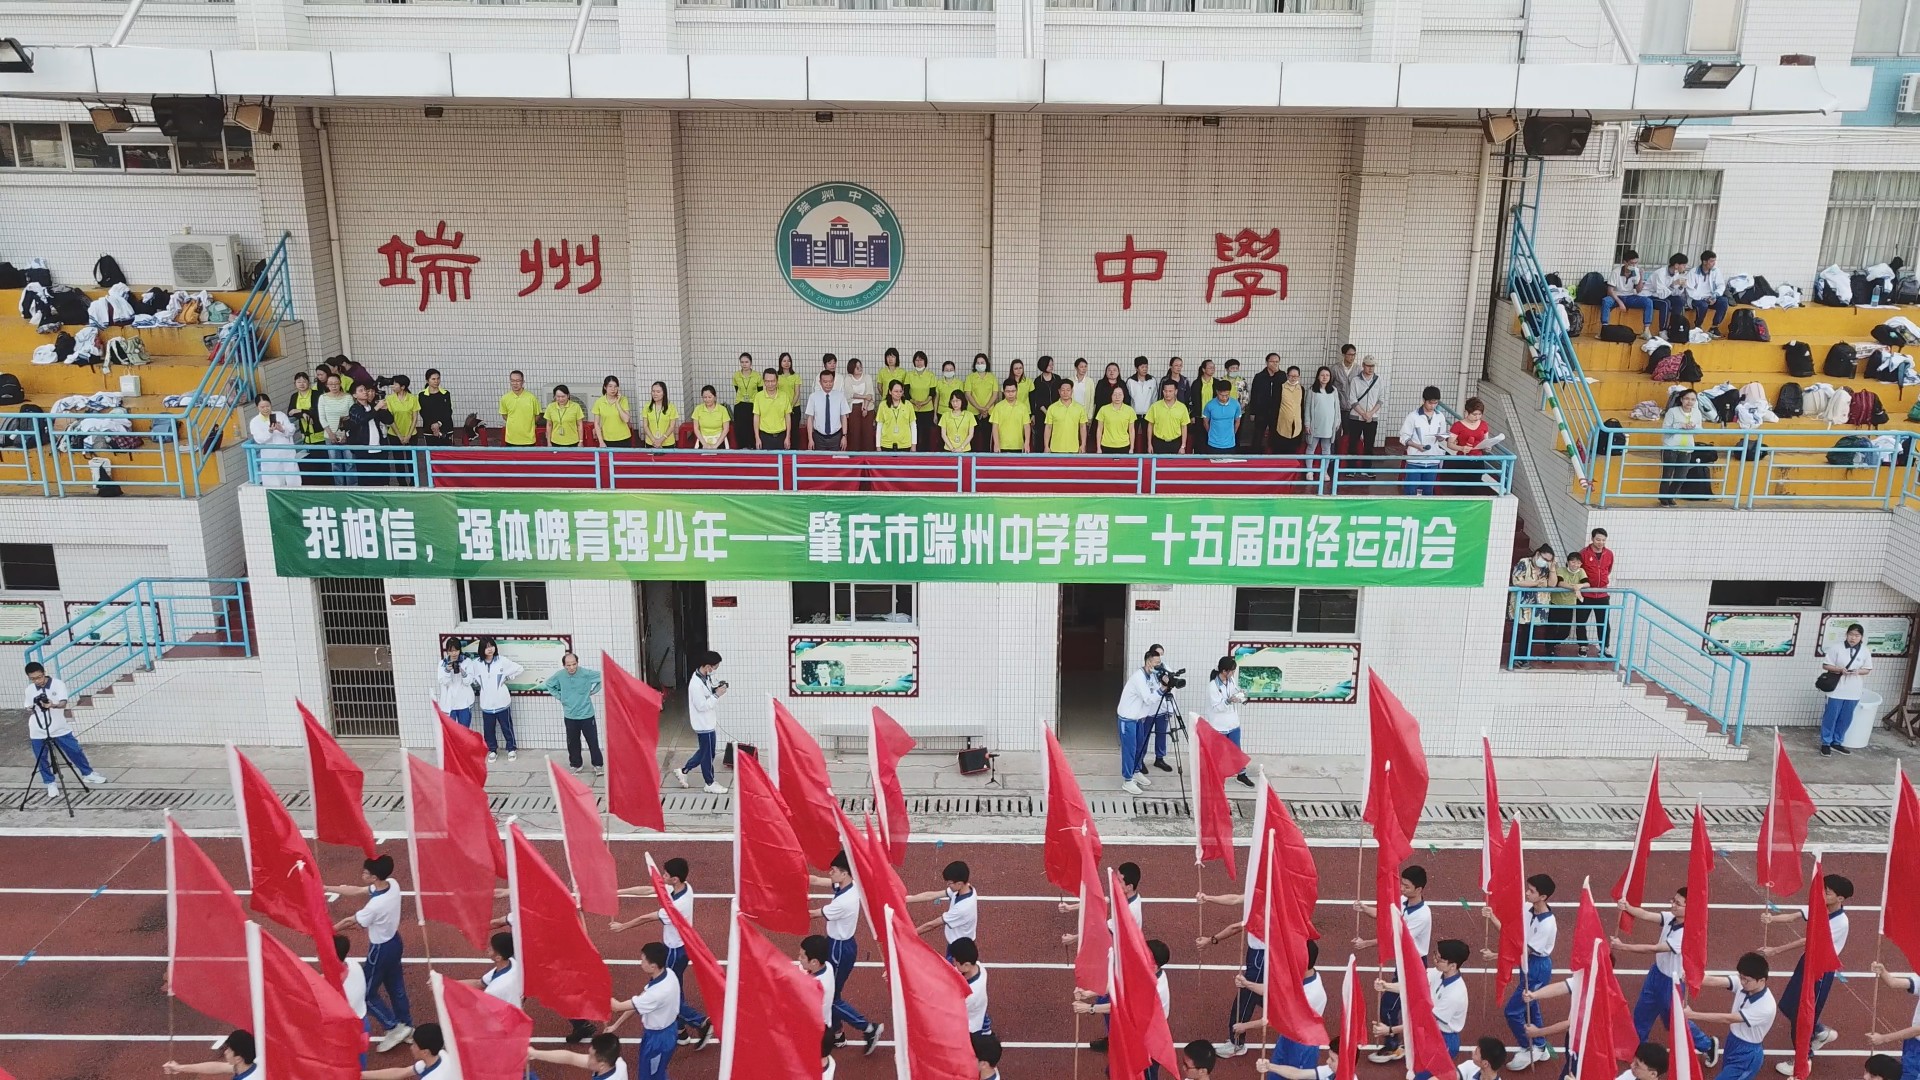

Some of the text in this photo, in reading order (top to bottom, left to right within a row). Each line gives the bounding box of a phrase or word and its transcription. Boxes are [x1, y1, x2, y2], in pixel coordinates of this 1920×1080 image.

[377, 220, 602, 311] 端州
[799, 282, 885, 307] DUAN ZHOU MIDDLE SCHOOL
